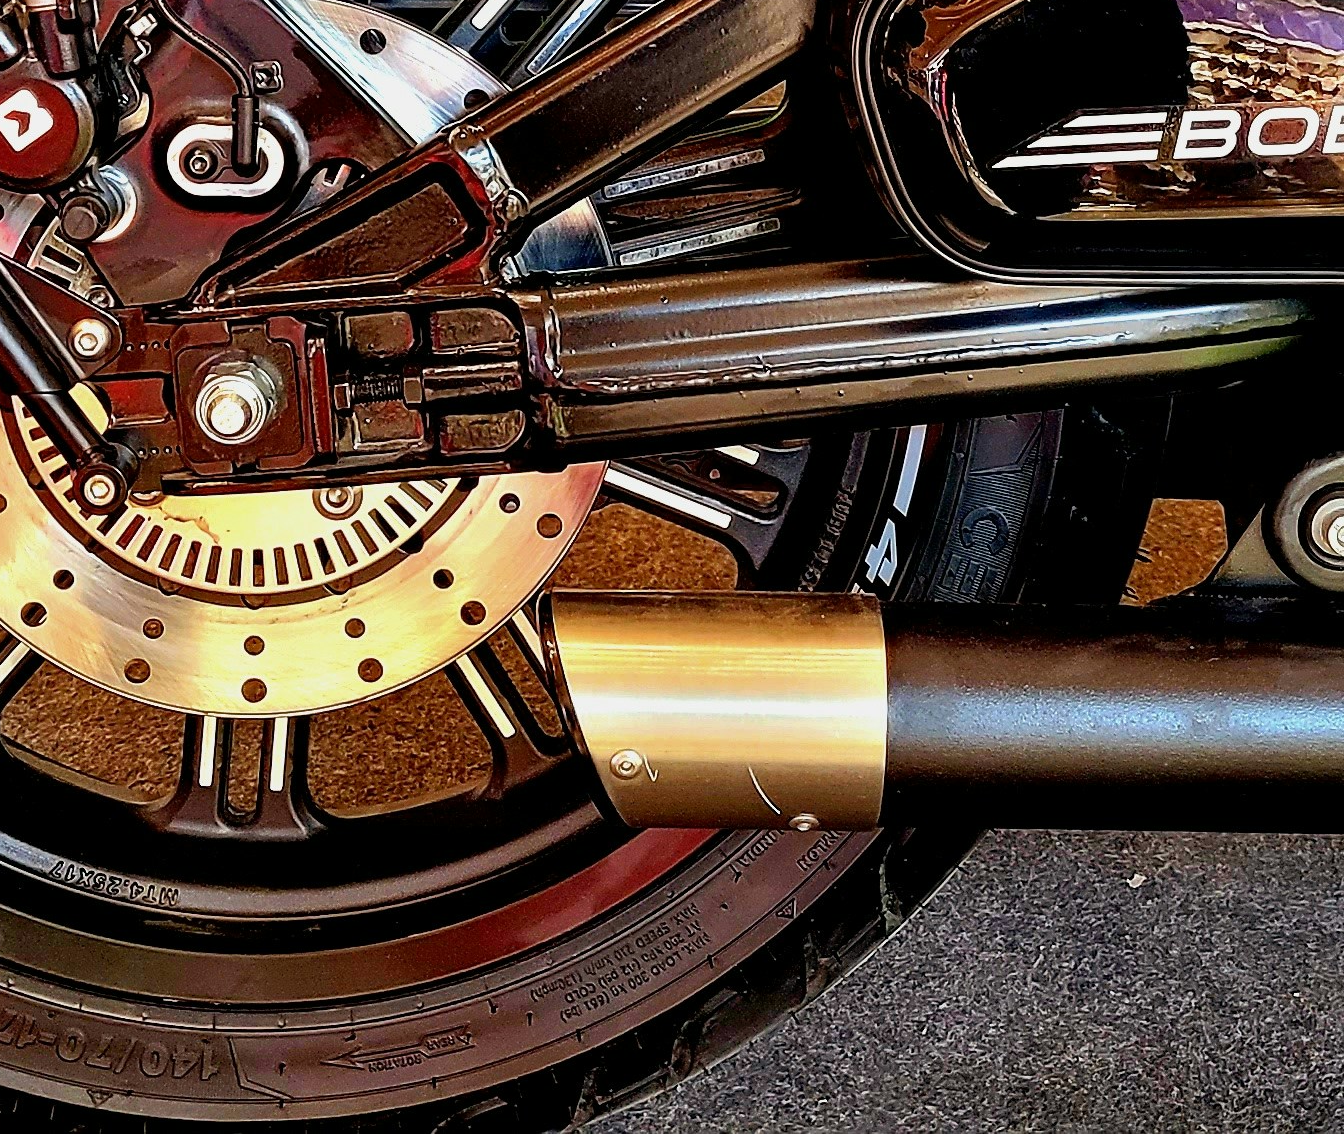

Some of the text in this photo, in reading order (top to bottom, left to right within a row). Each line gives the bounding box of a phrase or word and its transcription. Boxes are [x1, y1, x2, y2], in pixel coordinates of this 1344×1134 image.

[50, 861, 181, 907] MT4.25X17
[635, 922, 671, 949] SPEED
[651, 951, 682, 976] LOAD
[564, 983, 597, 1004] COLD
[425, 1035, 456, 1050] REAR
[368, 1054, 422, 1073] ROTATION
